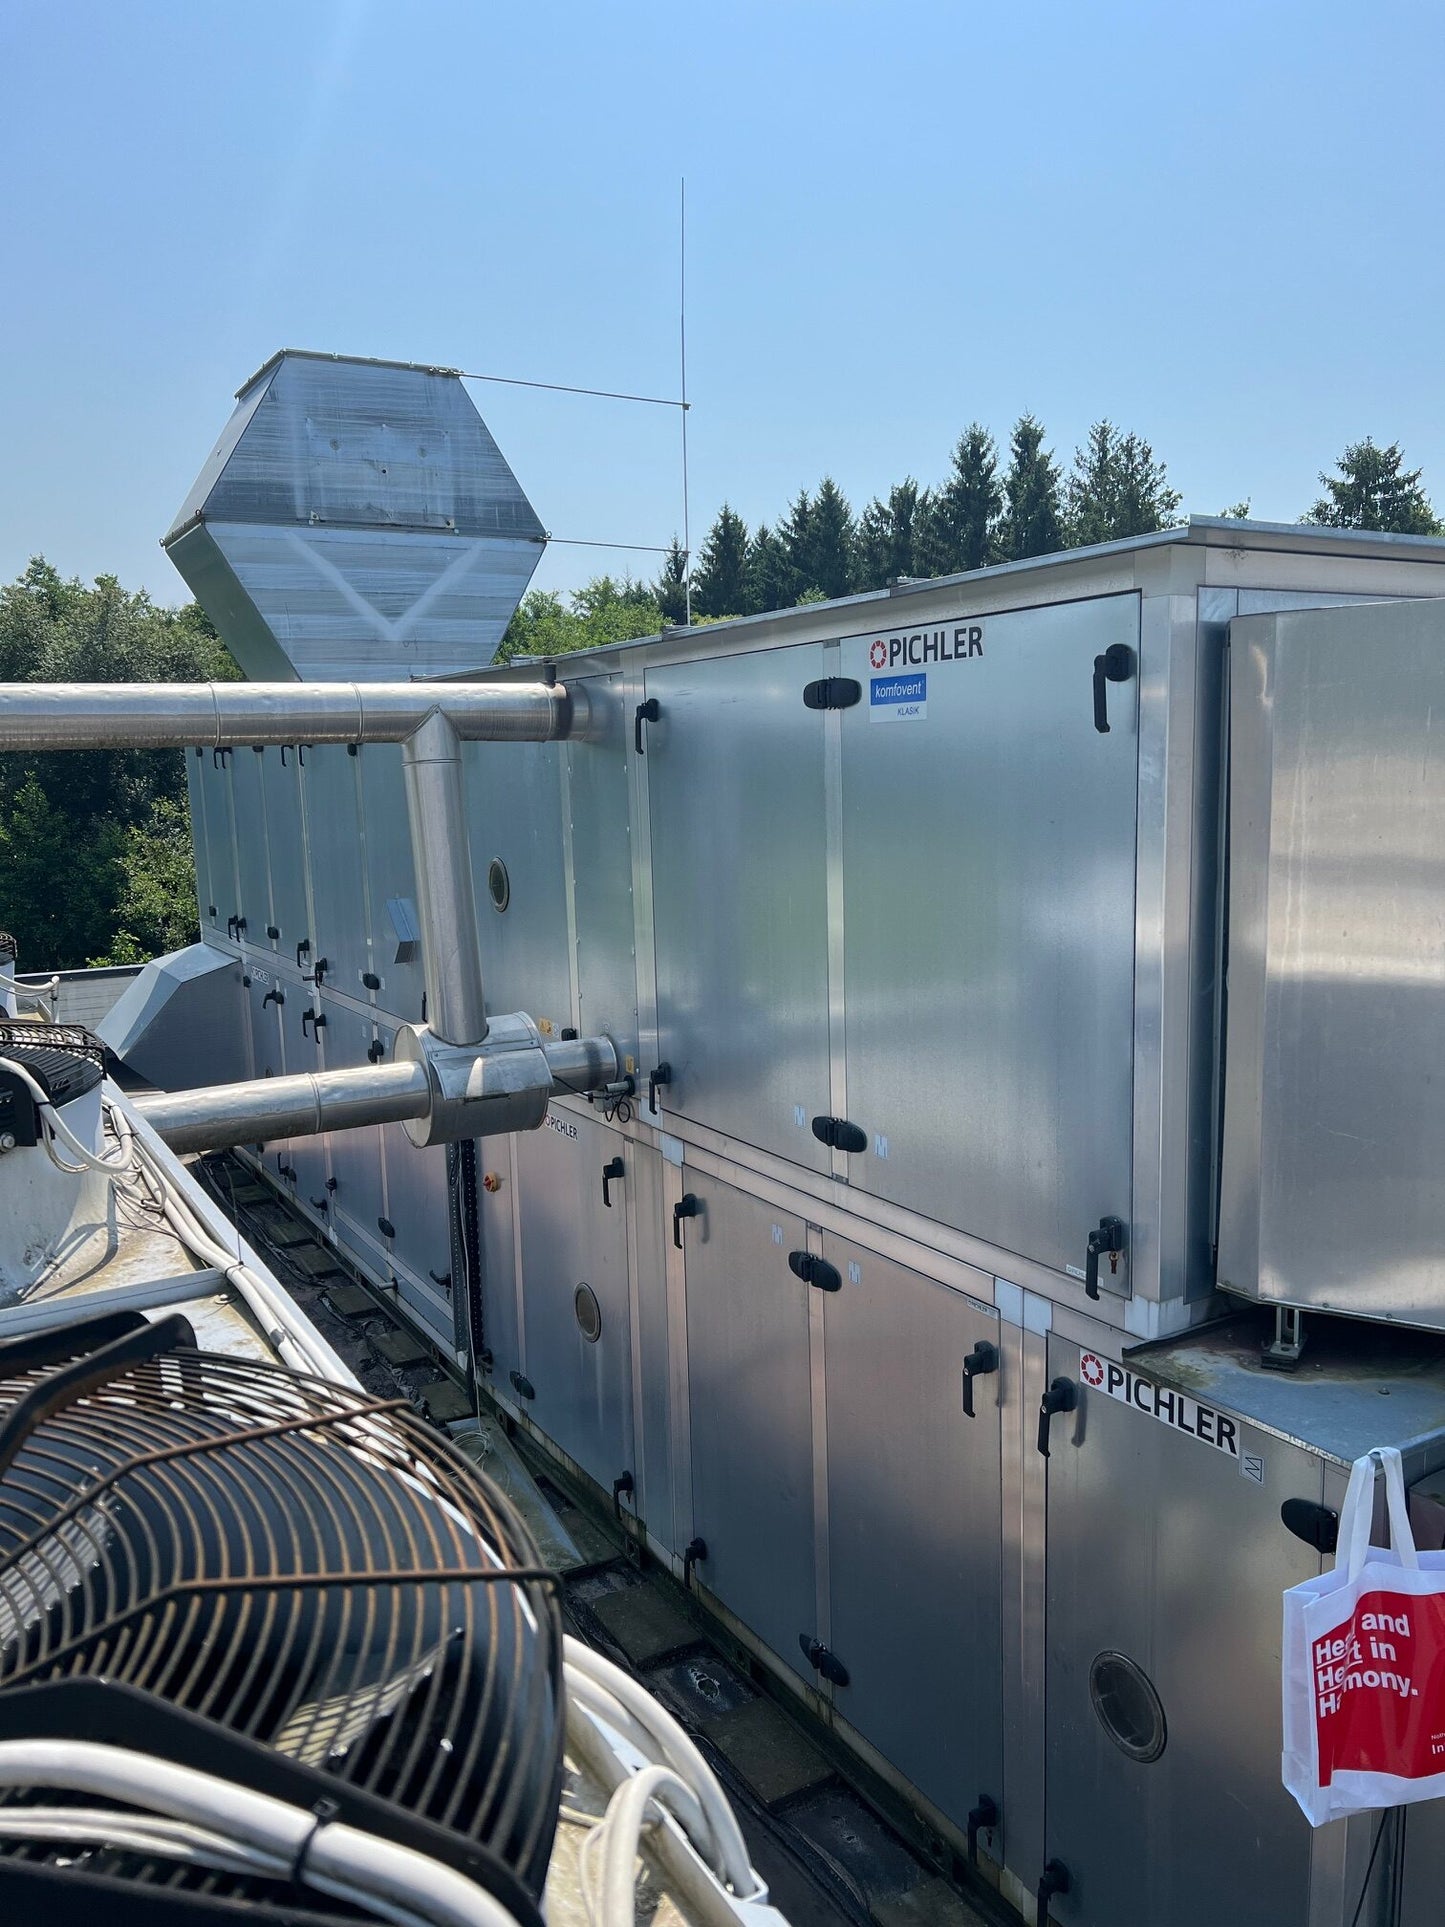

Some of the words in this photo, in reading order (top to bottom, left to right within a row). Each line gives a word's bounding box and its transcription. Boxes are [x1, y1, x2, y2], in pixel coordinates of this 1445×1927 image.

[889, 626, 983, 667] PICHLER
[875, 681, 922, 699] komfovent
[897, 706, 920, 717] KLASIK
[550, 1115, 578, 1140] PICHLER
[1107, 1363, 1238, 1456] PICHLER
[1361, 1612, 1411, 1638] and
[1369, 1636, 1397, 1662] in
[1431, 1743, 1445, 1755] In
